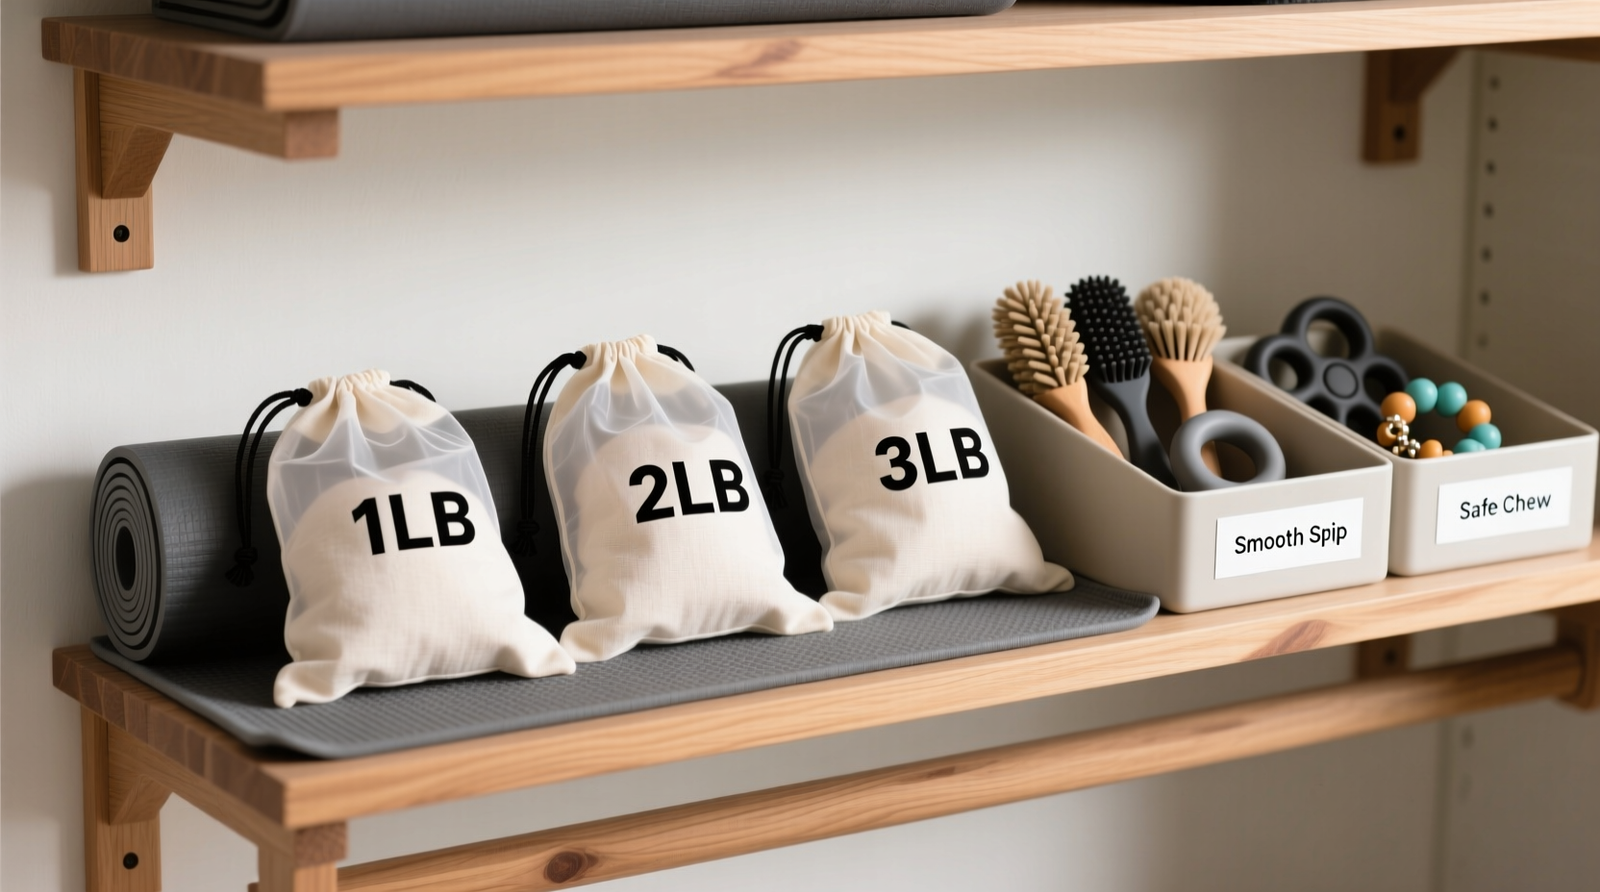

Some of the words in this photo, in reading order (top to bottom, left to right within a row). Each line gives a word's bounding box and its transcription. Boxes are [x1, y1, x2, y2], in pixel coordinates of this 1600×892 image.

[628, 459, 750, 524] 2LB
[875, 427, 990, 492] 3LB
[351, 491, 476, 556] 1LB
[1234, 526, 1304, 555] Smooth
[1309, 522, 1348, 548] Spip
[1460, 497, 1498, 520] Safe
[1503, 493, 1552, 514] Chew
